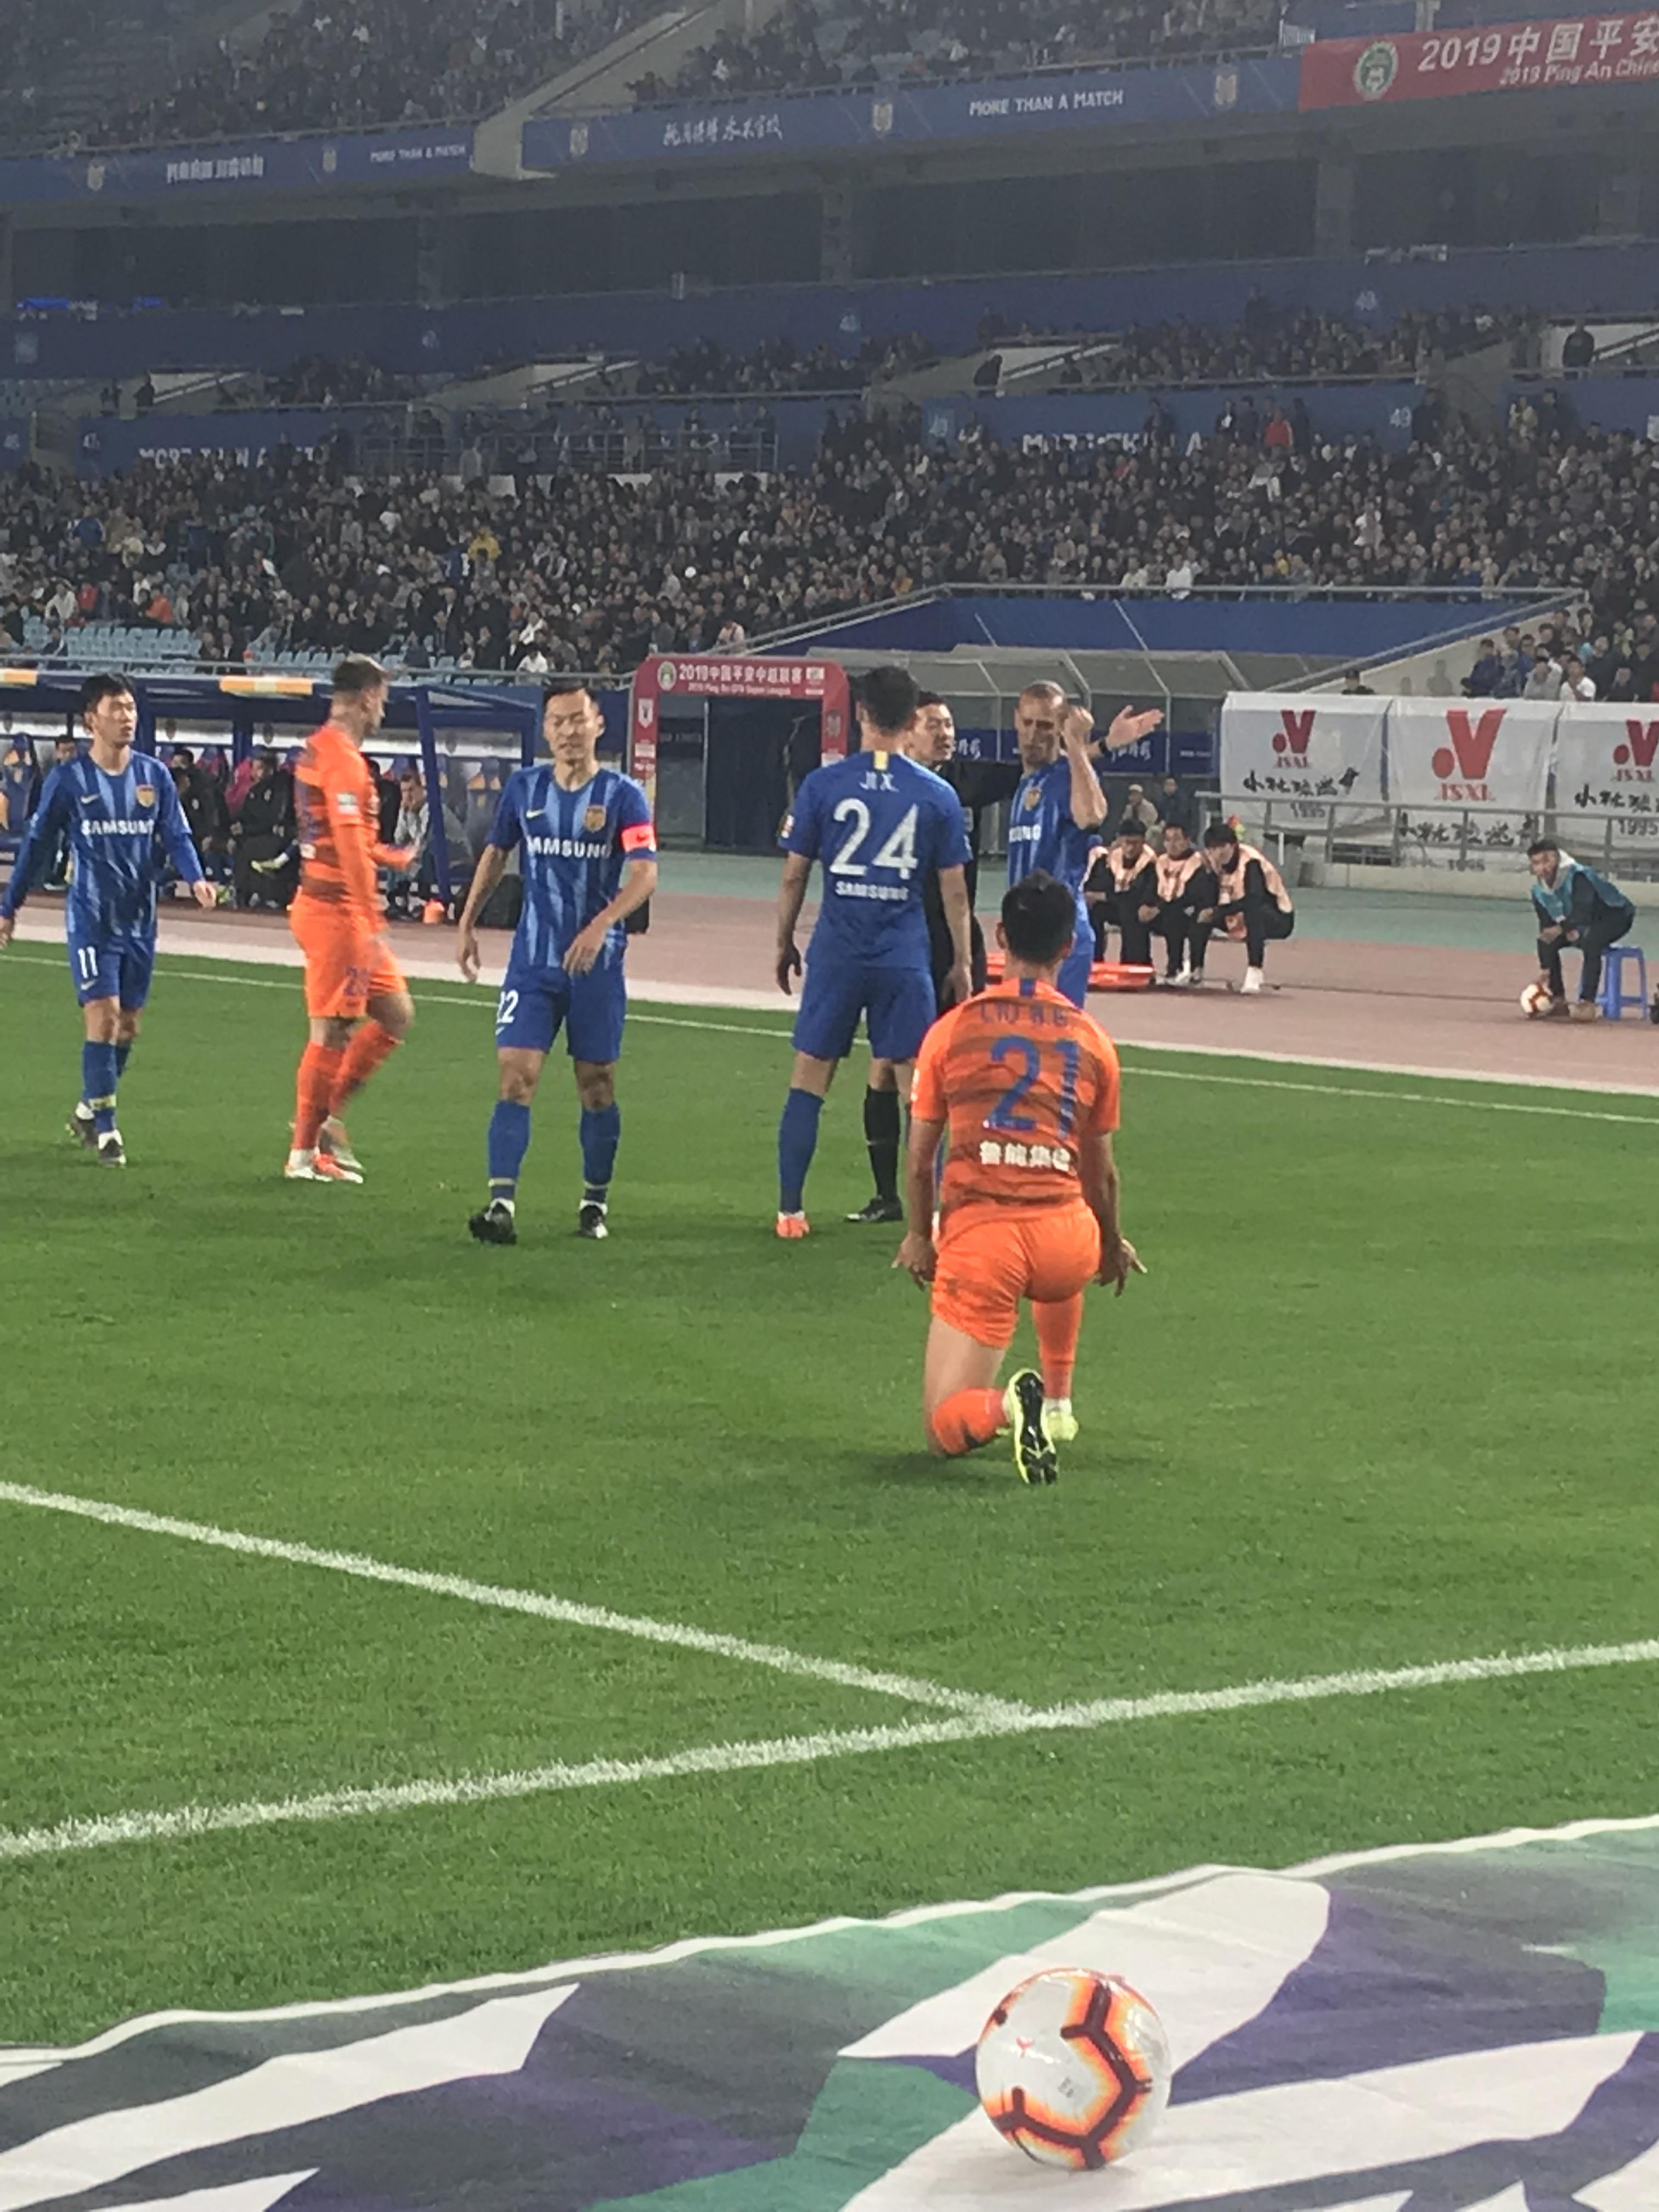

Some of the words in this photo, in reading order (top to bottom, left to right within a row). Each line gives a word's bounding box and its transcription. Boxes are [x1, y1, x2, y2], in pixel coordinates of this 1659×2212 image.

[1544, 63, 1583, 86] Ping
[1584, 60, 1612, 79] An
[1015, 96, 1053, 112] THAN
[1058, 94, 1069, 109] A
[1074, 89, 1124, 109] MATCH
[526, 835, 611, 858] AMSUN
[830, 798, 919, 880] 24
[78, 946, 98, 979] 11
[988, 1035, 1079, 1138] 21
